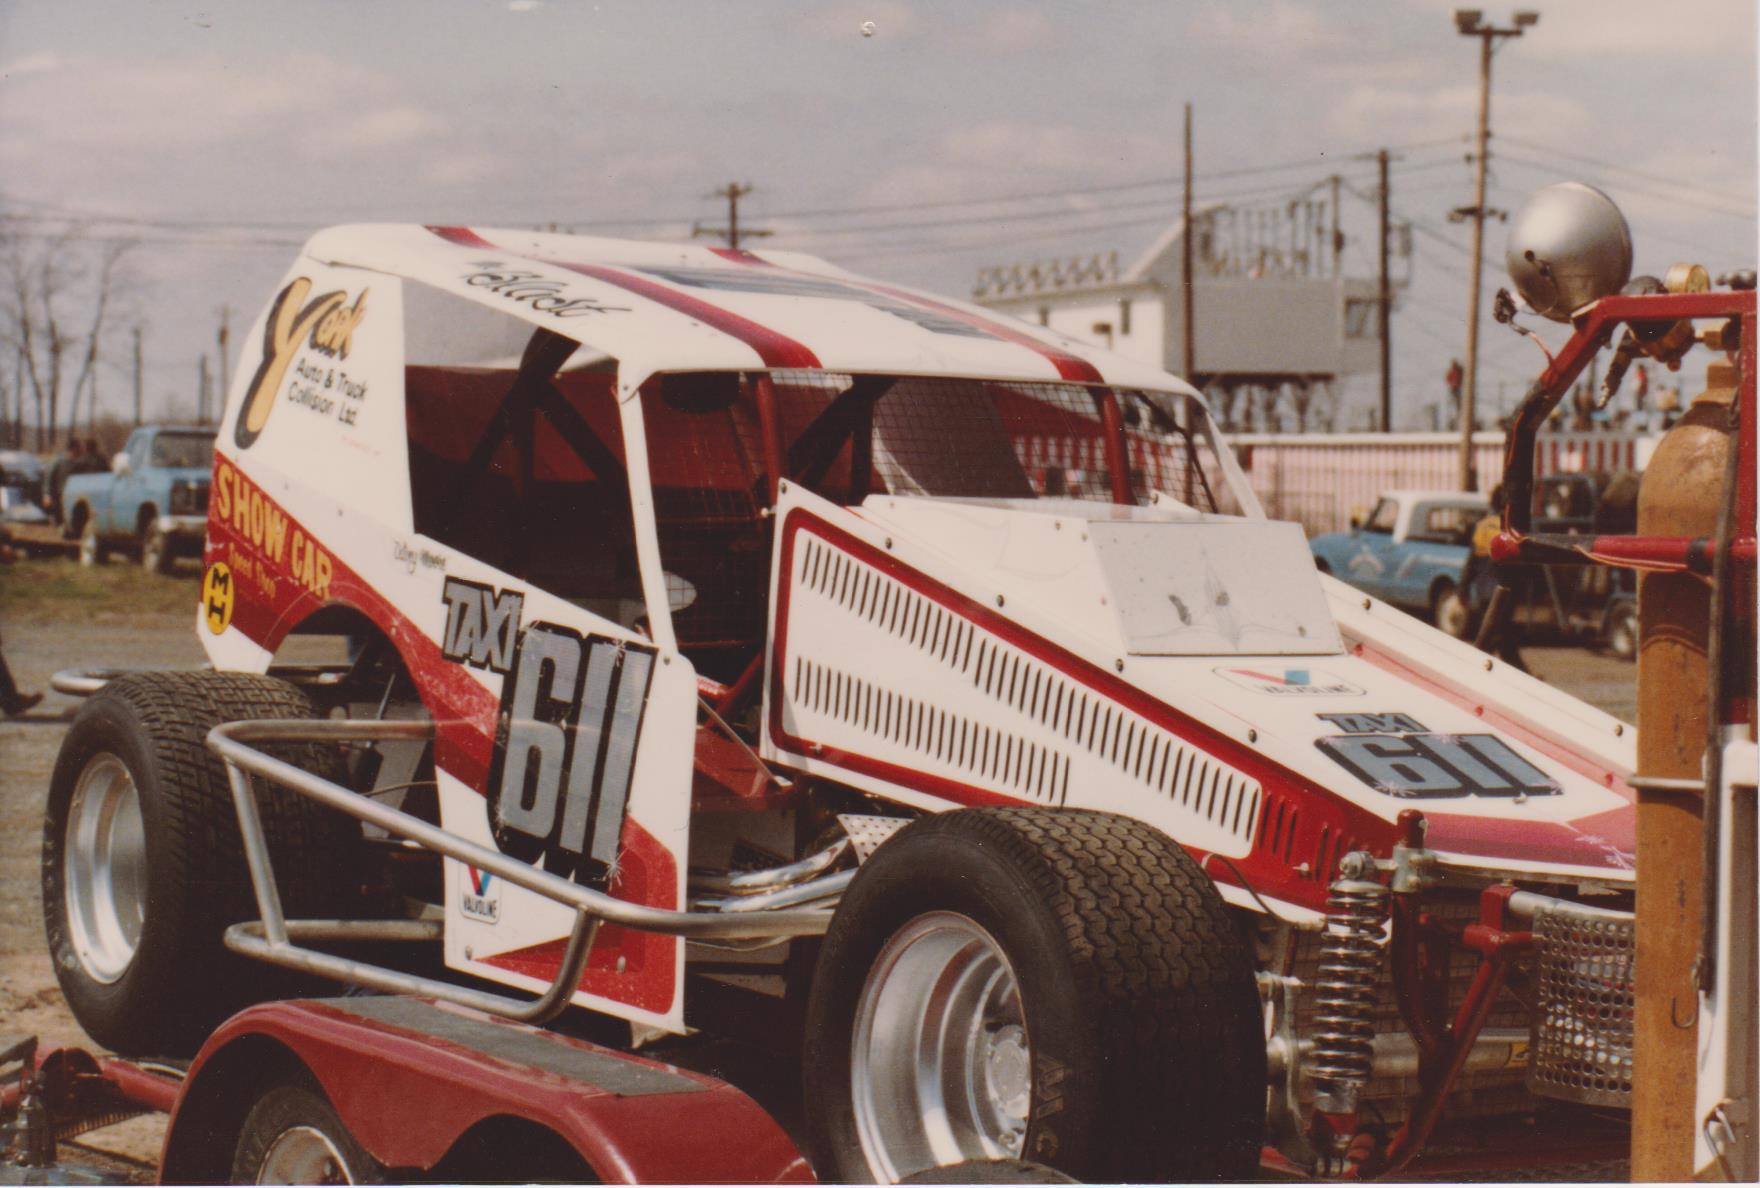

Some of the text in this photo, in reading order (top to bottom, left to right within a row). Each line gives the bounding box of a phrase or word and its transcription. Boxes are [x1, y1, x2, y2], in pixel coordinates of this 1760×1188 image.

[288, 381, 334, 414] Collision
[296, 357, 369, 401] Auto & Truck
[217, 463, 288, 564] SHOW
[291, 530, 333, 601] CAR
[442, 575, 524, 674] TAXI
[1316, 712, 1430, 733] TAXI
[488, 621, 659, 890] 611
[1313, 733, 1563, 799] 611
[463, 893, 497, 919] VALVOLINE
